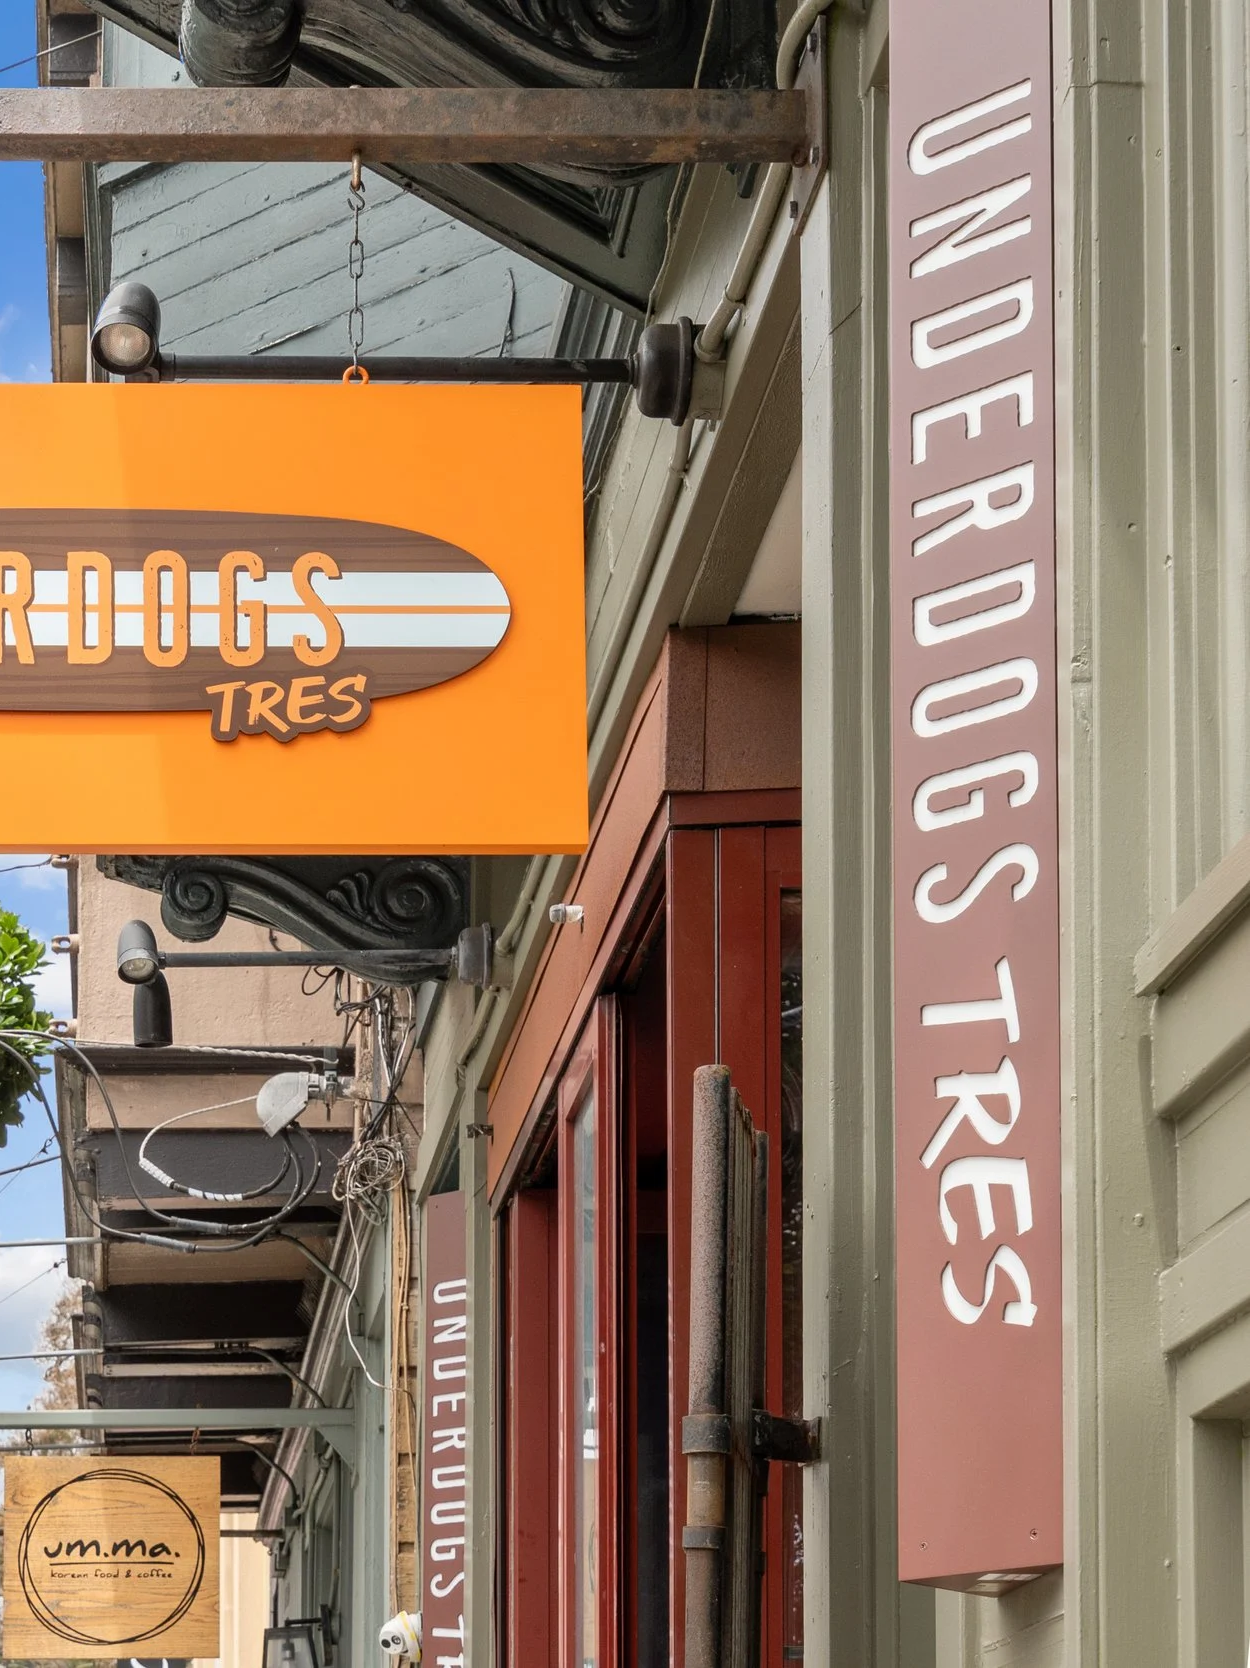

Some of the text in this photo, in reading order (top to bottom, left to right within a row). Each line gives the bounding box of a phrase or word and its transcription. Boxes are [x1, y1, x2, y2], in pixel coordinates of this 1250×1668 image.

[206, 674, 367, 733] TRES
[908, 78, 1039, 1327] UNDERDOGS TRES
[430, 1279, 467, 1598] UNDERDOGS
[50, 1568, 173, 1579] korean food & coffee
